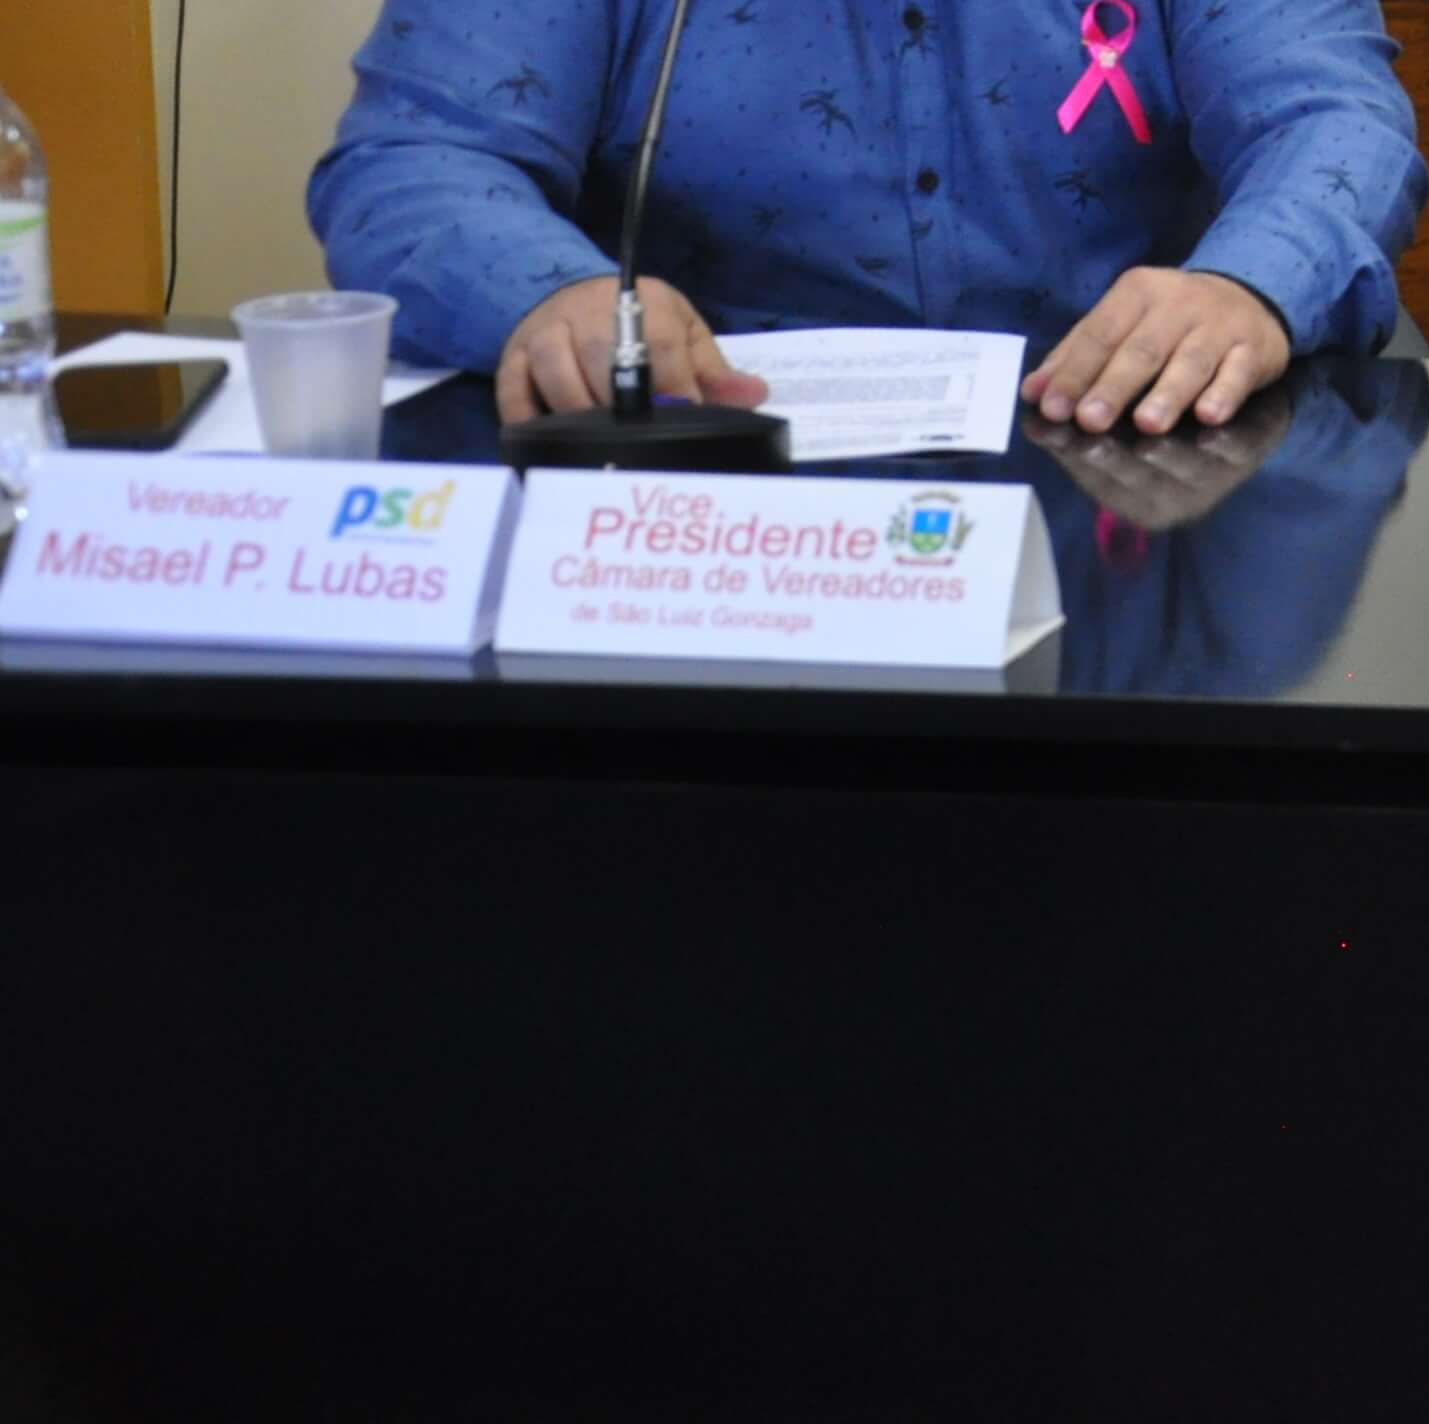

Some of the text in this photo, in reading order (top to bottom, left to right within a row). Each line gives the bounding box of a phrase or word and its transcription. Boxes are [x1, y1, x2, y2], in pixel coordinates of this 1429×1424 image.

[127, 480, 290, 521] Vereador
[328, 481, 456, 539] psd
[630, 485, 714, 519] Vice
[583, 507, 878, 561] Presidente
[35, 529, 449, 603] Misael P. Lubas
[551, 554, 966, 602] Câmara de Vereadores
[570, 603, 813, 633] de São Luiz Gonzaga
